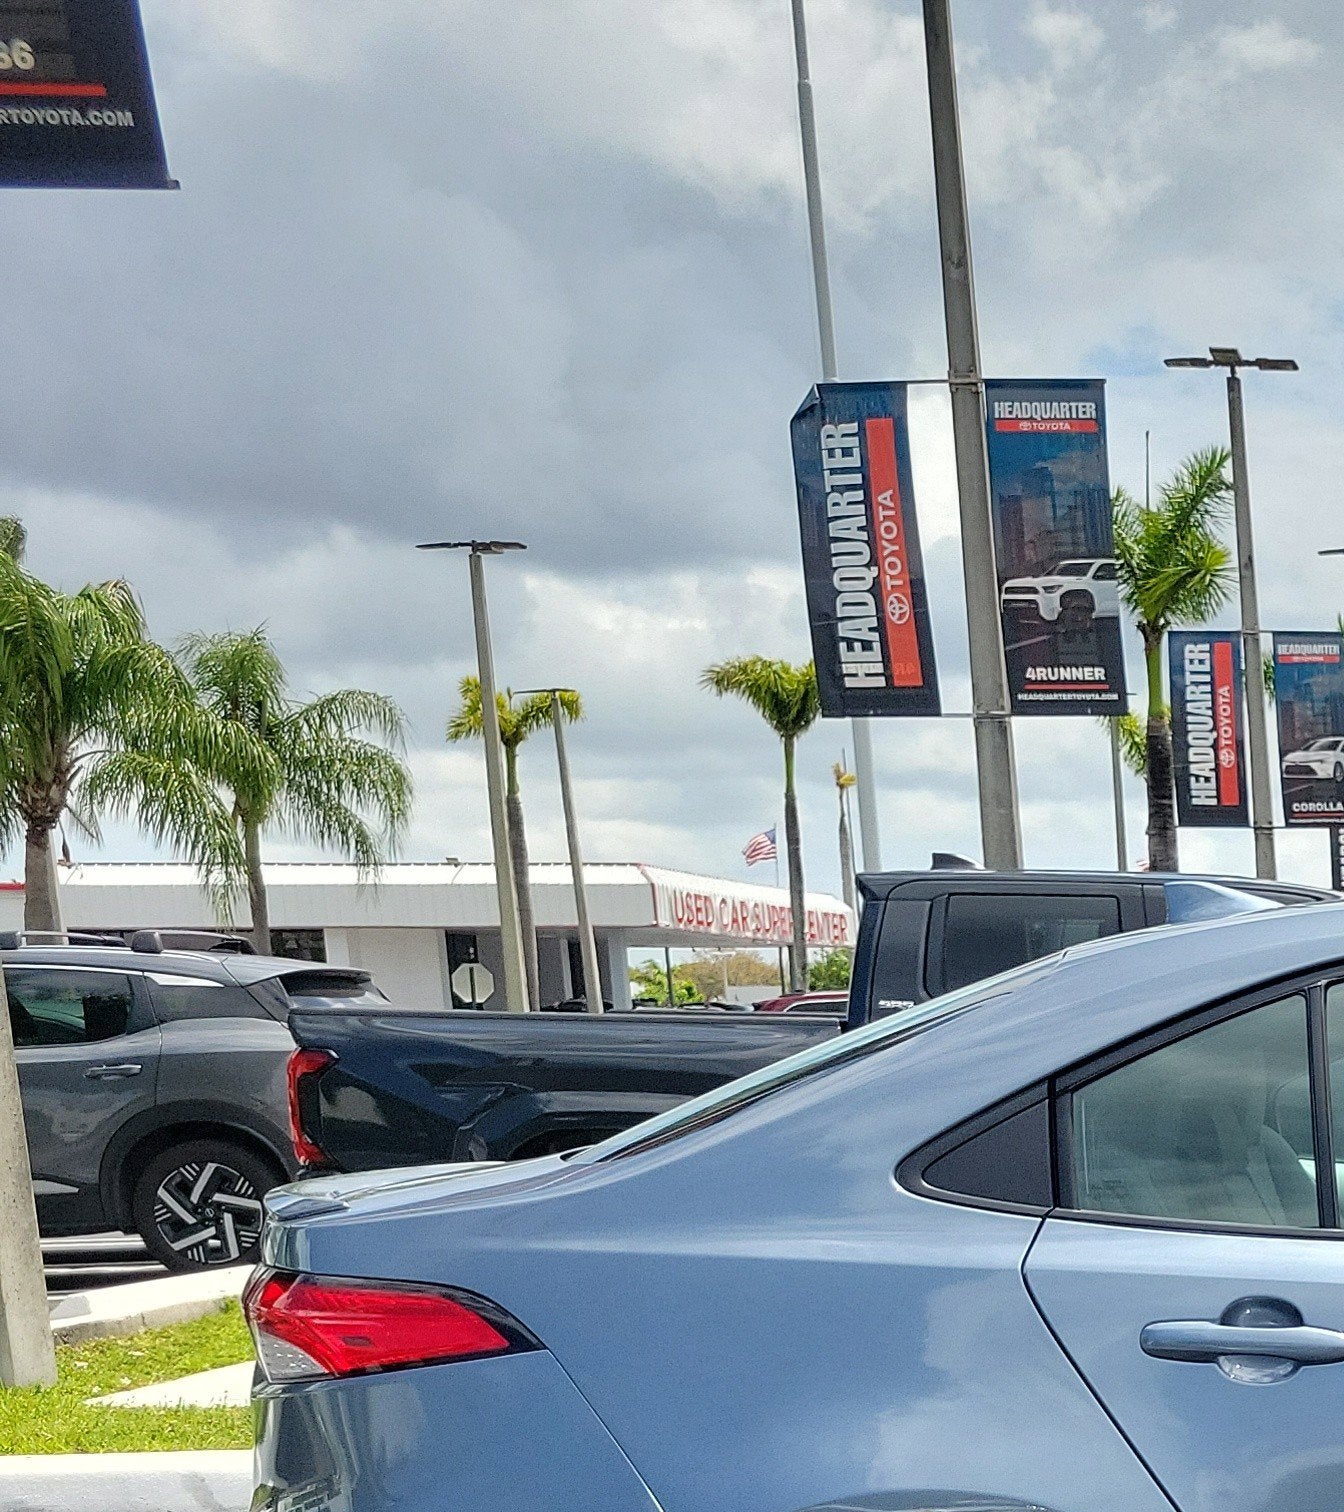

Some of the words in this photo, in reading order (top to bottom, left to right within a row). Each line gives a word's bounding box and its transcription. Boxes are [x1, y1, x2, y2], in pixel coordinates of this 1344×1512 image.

[994, 402, 1097, 421] HEADQUARTER
[1033, 422, 1071, 430] TOYOTA
[821, 421, 887, 689] HEADQUARTER
[877, 489, 905, 590] TOYOTA
[1025, 666, 1106, 681] 4RUNNER
[1184, 642, 1218, 806] HEADQUARTER
[1218, 685, 1233, 745] TOYOTA
[1292, 801, 1344, 812] COROLLA
[673, 888, 715, 928] USED
[719, 898, 750, 932] CAR
